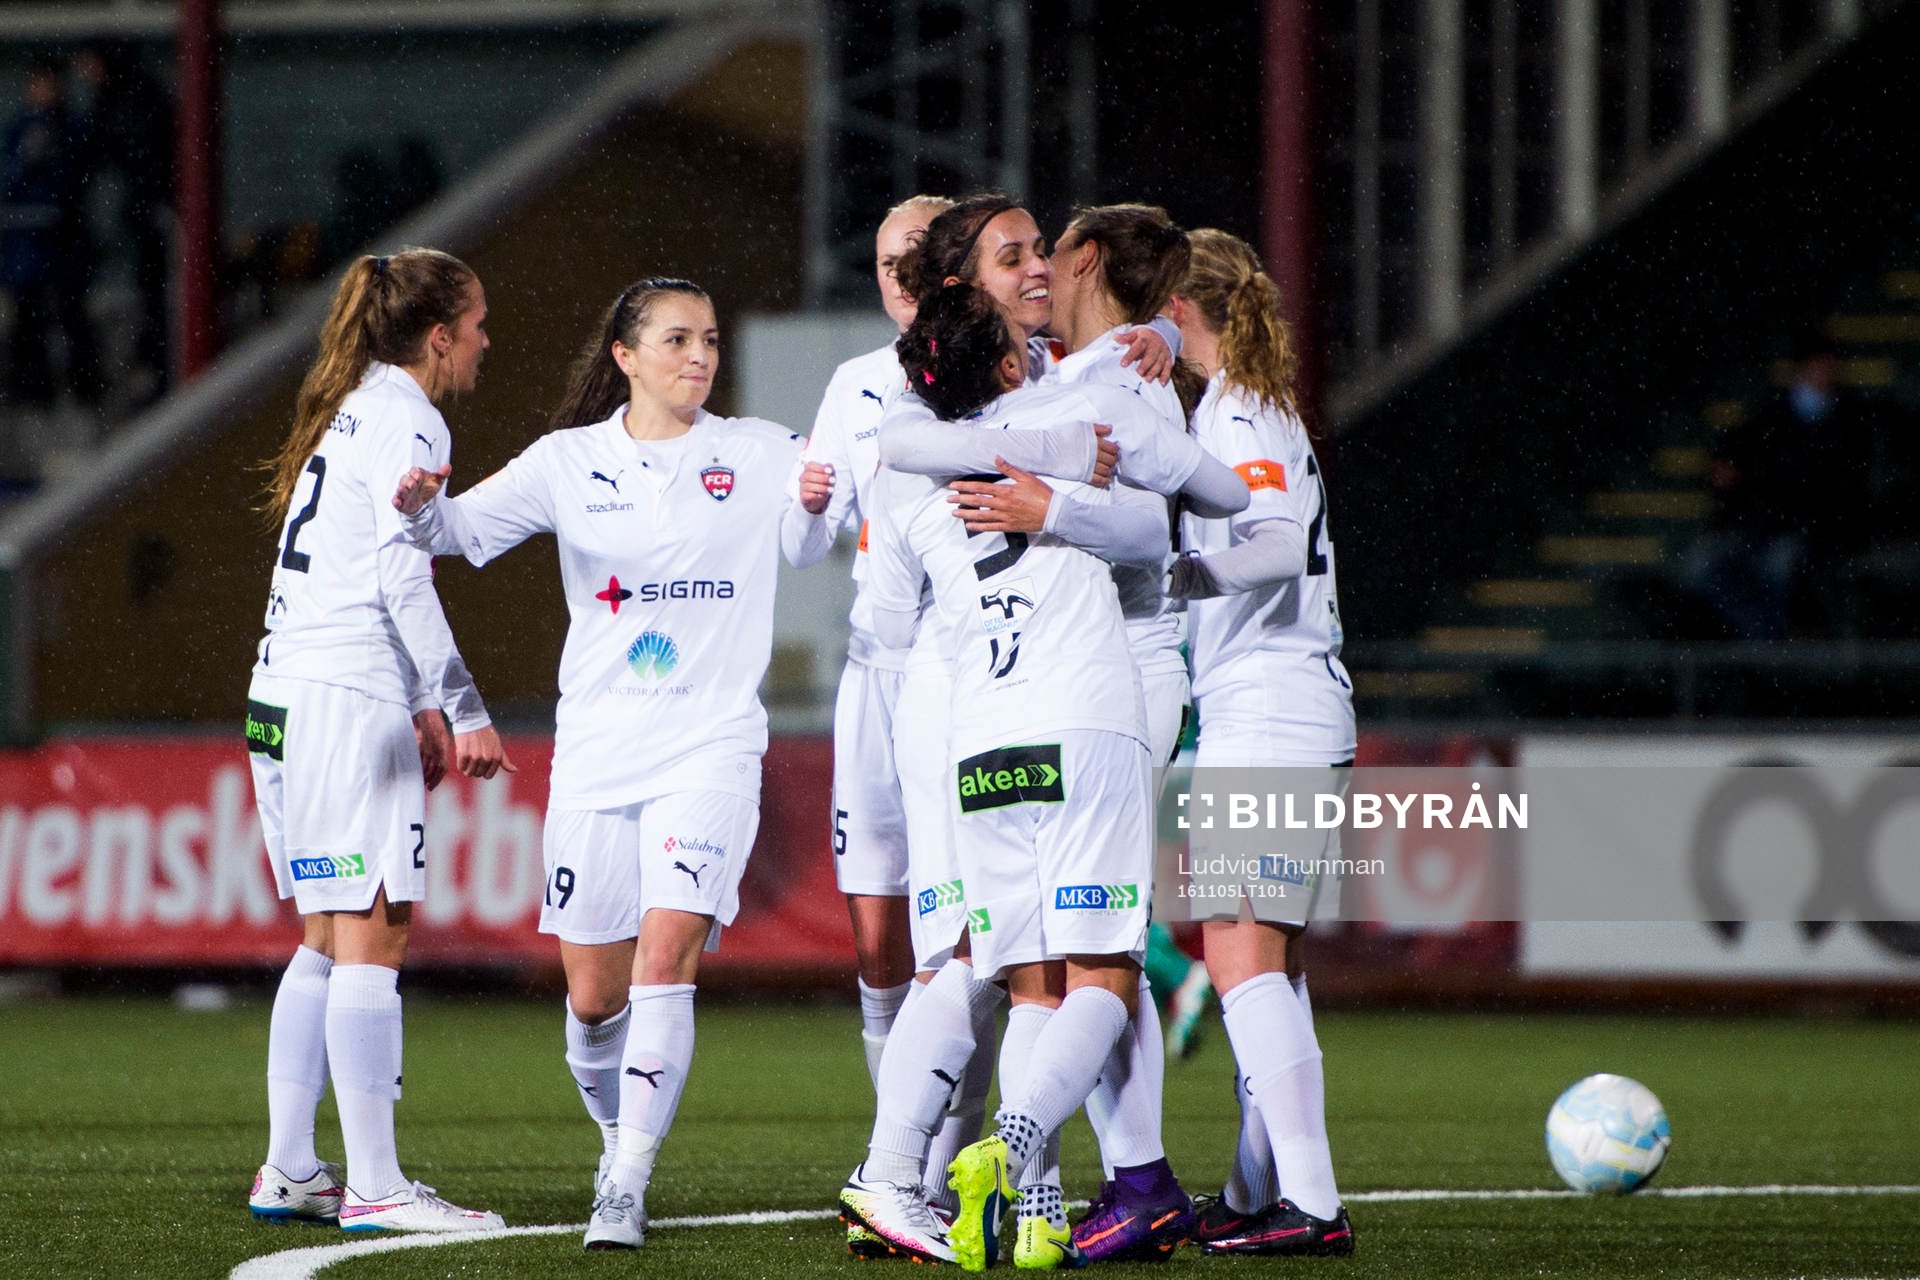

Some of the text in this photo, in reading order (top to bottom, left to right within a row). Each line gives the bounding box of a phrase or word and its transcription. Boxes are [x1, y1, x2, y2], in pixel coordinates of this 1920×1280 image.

[705, 474, 732, 485] FCR
[281, 454, 326, 574] 2
[586, 502, 634, 513] stadium
[640, 580, 734, 602] SIGMA
[607, 684, 690, 697] VICTORA ARK
[961, 767, 1029, 797] akea
[410, 823, 425, 869] 2
[297, 860, 333, 877] MKB
[1059, 888, 1102, 906] MKB
